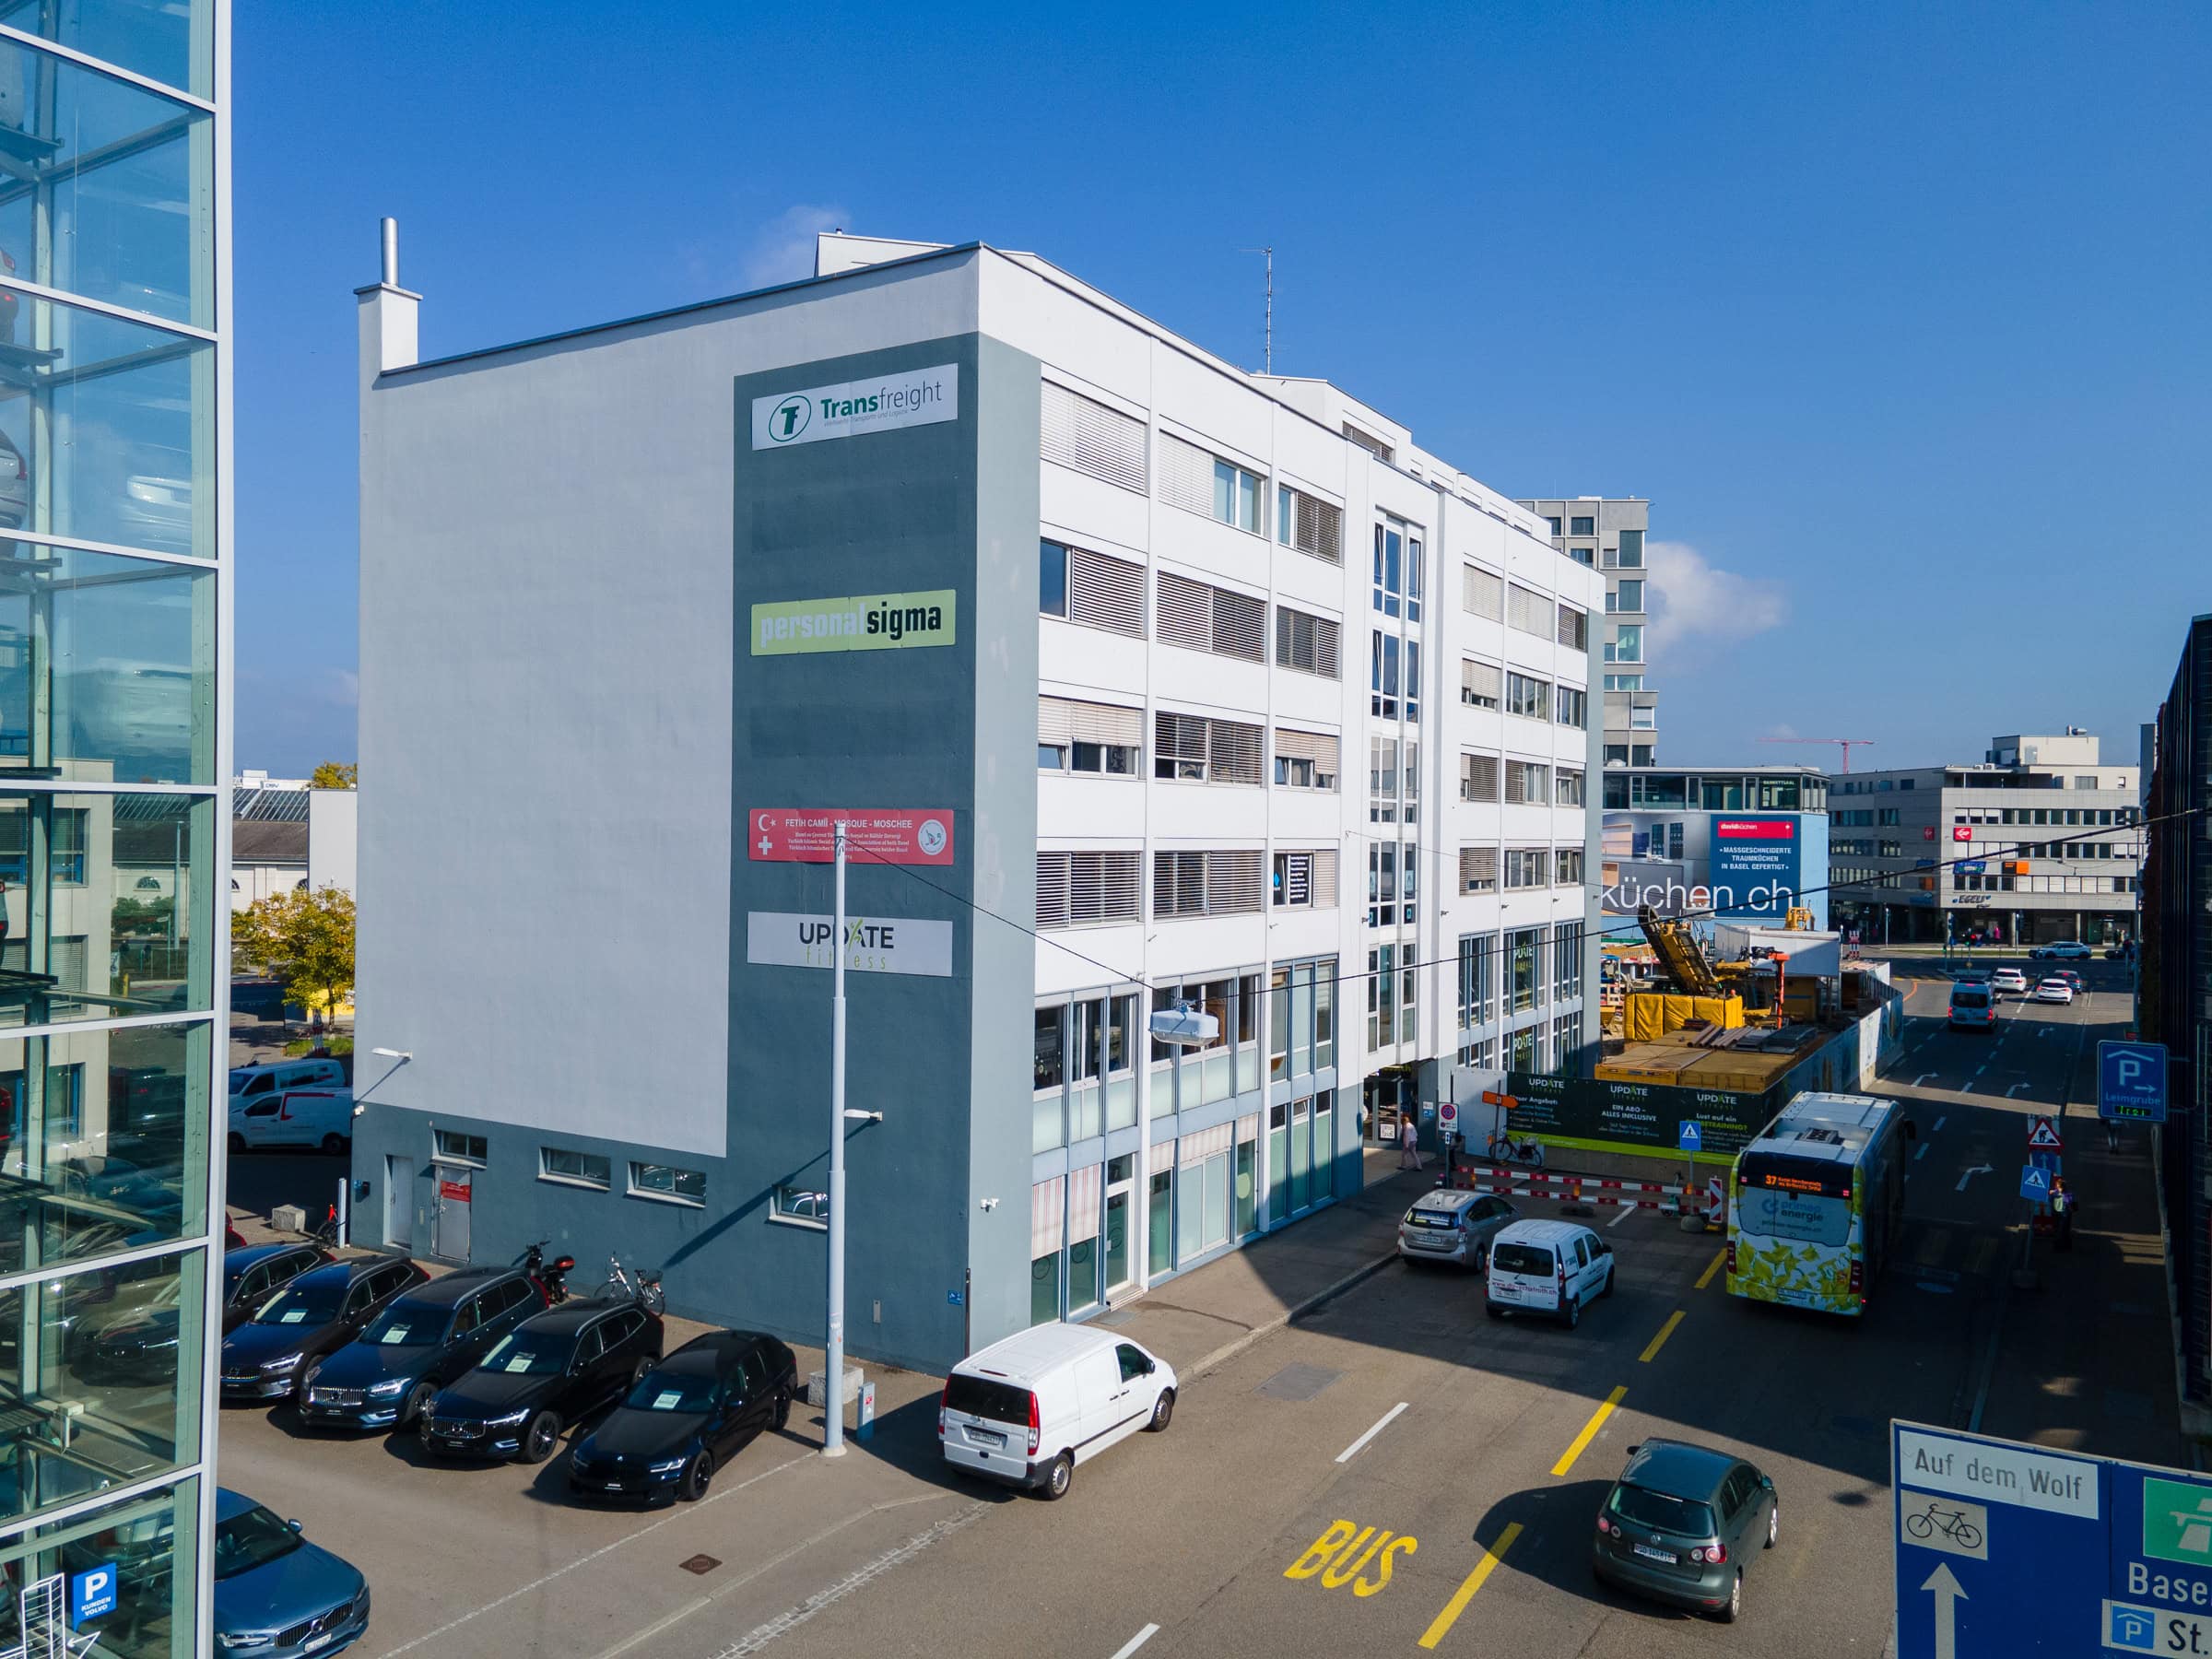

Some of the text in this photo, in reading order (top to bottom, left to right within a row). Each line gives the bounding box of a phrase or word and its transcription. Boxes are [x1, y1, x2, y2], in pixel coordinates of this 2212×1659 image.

[820, 379, 943, 420] Transfreight
[874, 819, 912, 829] MOSCHEE
[806, 947, 886, 970] fitess
[1528, 1077, 1565, 1088] UPDATE
[1610, 1084, 1649, 1097] UPDATE
[1696, 1093, 1738, 1105] UPDATE
[2105, 1091, 2161, 1106] Leimgrube
[1602, 1110, 1620, 1118] ALLES
[1765, 1174, 1777, 1186] 37
[1781, 1209, 1824, 1223] energie
[1914, 1447, 2083, 1500] Auf dem Wolf
[1282, 1519, 1418, 1598] BUS
[85, 1571, 108, 1601] P
[2128, 1560, 2212, 1606] Base
[81, 1595, 112, 1612] KUNDEN
[84, 1604, 108, 1617] VOLVO
[2168, 1618, 2209, 1658] St.
